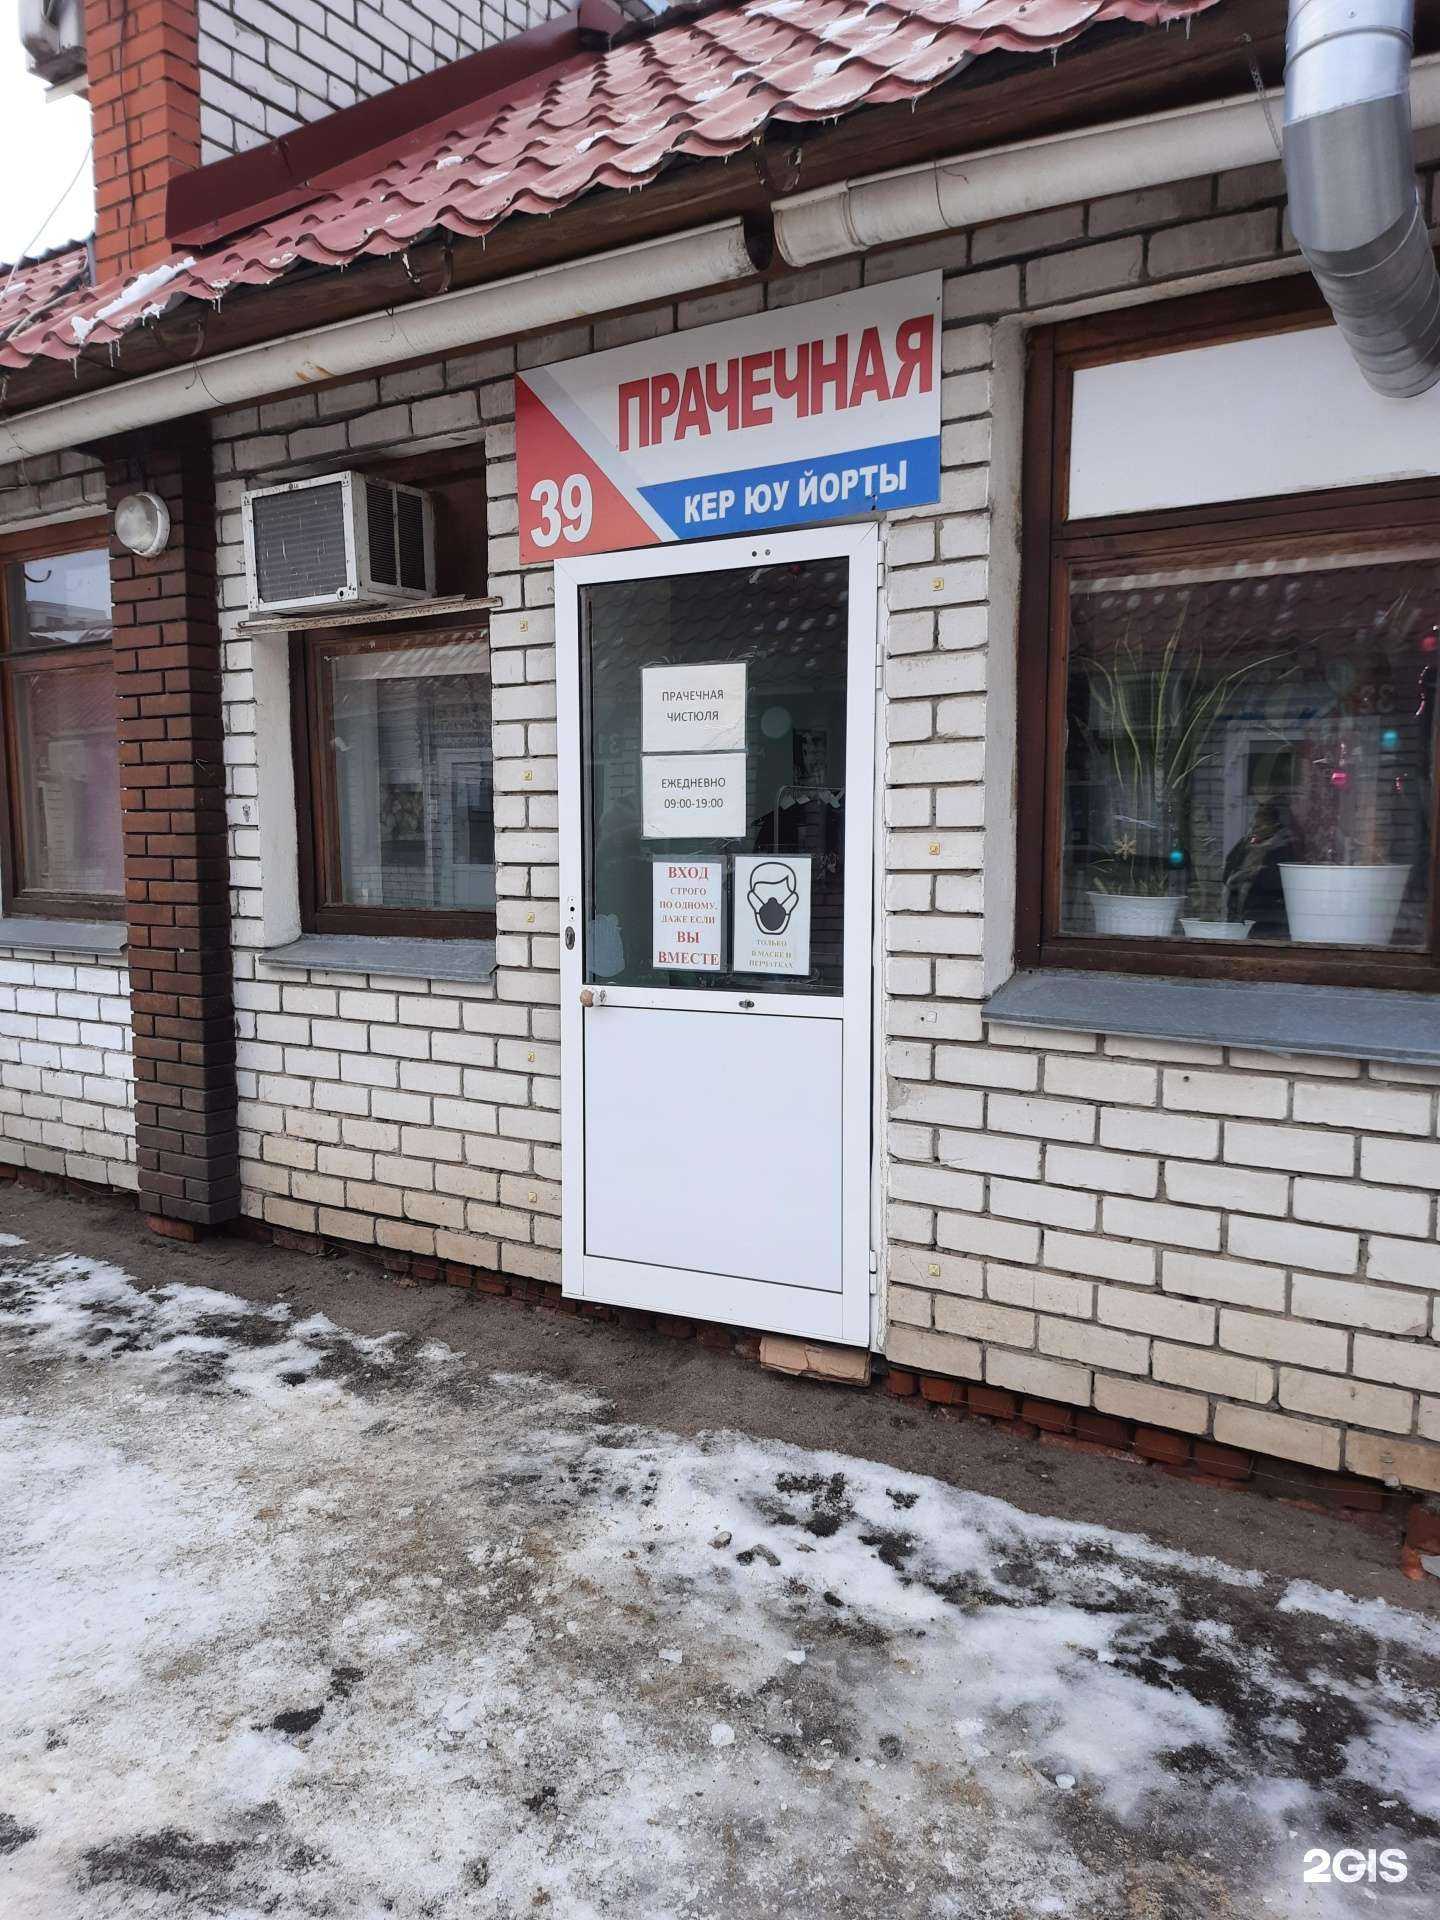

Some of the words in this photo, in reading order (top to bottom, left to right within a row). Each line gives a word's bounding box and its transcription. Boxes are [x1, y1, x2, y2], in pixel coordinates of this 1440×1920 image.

[618, 313, 935, 452] ПРАЧЕЧНАЯ
[684, 490, 735, 524] КЕР
[744, 481, 790, 514] ЮУ
[799, 460, 908, 507] ЙОРТЫ
[529, 473, 593, 548] 39
[662, 689, 724, 702] ПРАЧЕЧНАЯ
[667, 711, 719, 722] ЧИСТЮЛЯ
[661, 777, 726, 790] ЕЖЕДНЕВНО
[664, 799, 724, 809] 09:00-19:00
[668, 866, 709, 880] ВХОД
[670, 887, 707, 896] СТРОГО
[659, 901, 673, 909] ПО
[661, 915, 688, 923] ДАЖЕ
[690, 915, 715, 924] ЕСЛИ
[677, 931, 700, 943] ВЫ
[658, 951, 720, 966] ВМЕСТЕ
